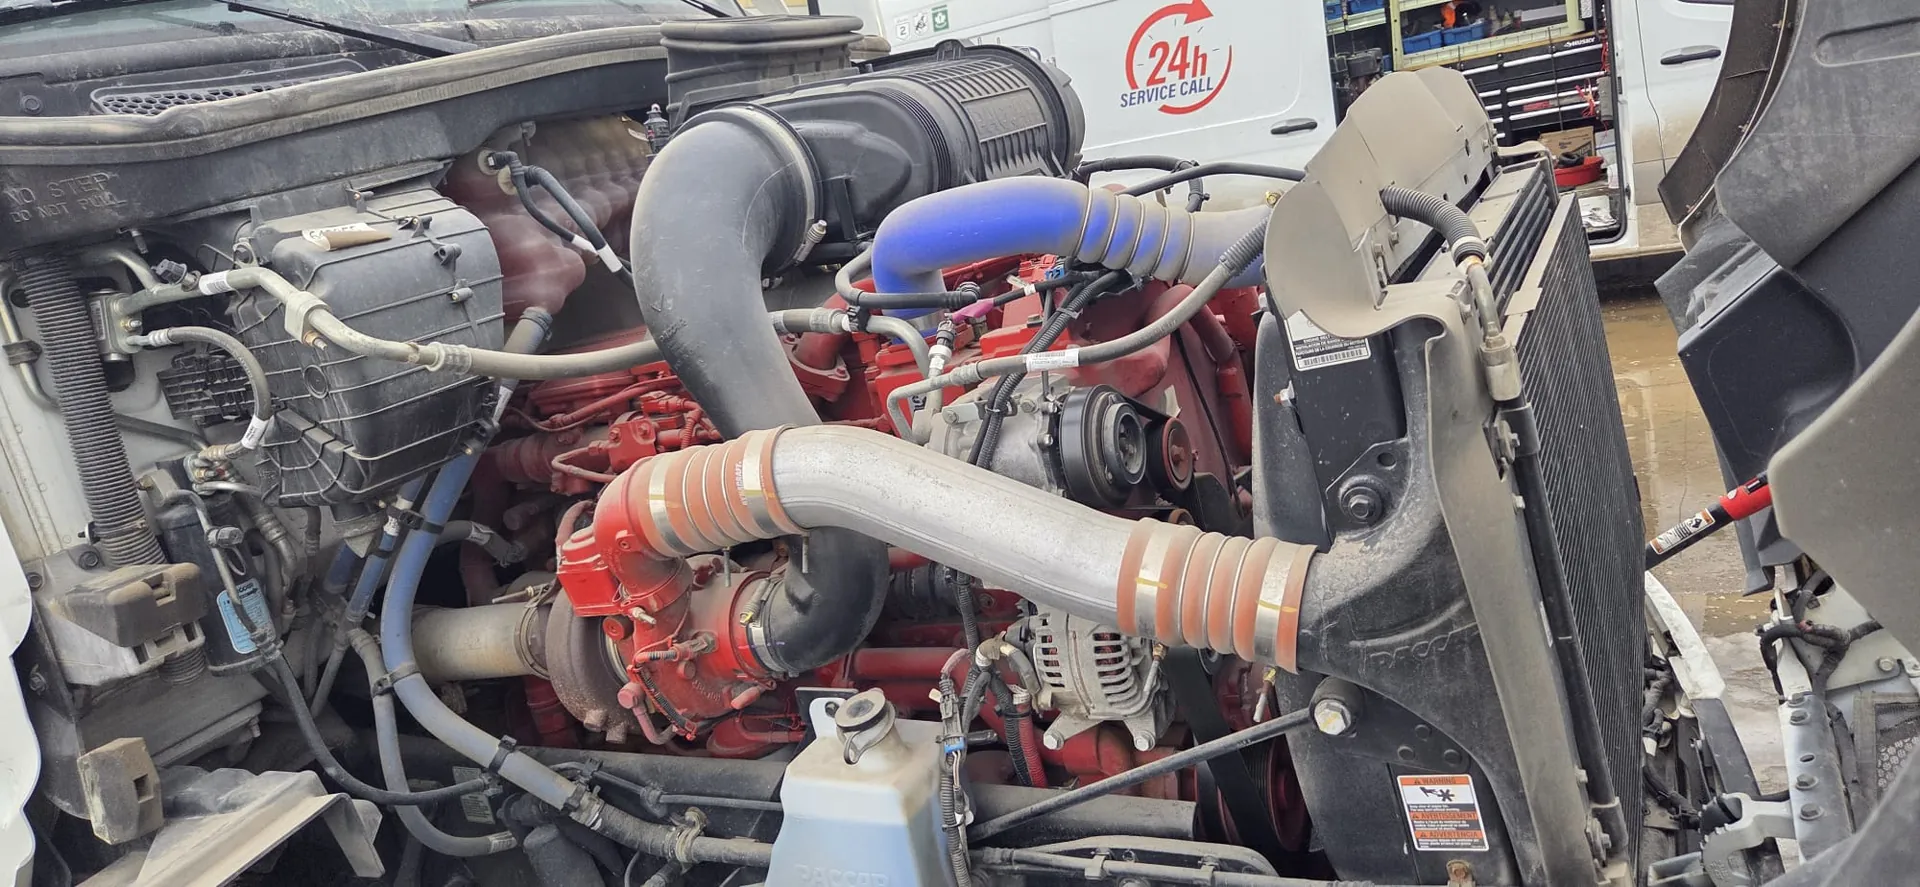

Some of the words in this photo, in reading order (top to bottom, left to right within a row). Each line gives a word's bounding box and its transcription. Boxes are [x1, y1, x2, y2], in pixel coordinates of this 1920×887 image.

[899, 25, 907, 36] 2
[1146, 35, 1208, 87] 24h
[1119, 83, 1176, 108] SERVICE
[1179, 76, 1214, 96] CALL
[47, 172, 110, 198] STEP
[9, 209, 32, 223] DO
[36, 201, 69, 219] NOT
[77, 190, 128, 210] PULL
[1423, 777, 1456, 785] WARNING
[1421, 812, 1477, 820] AVERTISSEMENT
[1429, 831, 1478, 839] ADVERTENCIA
